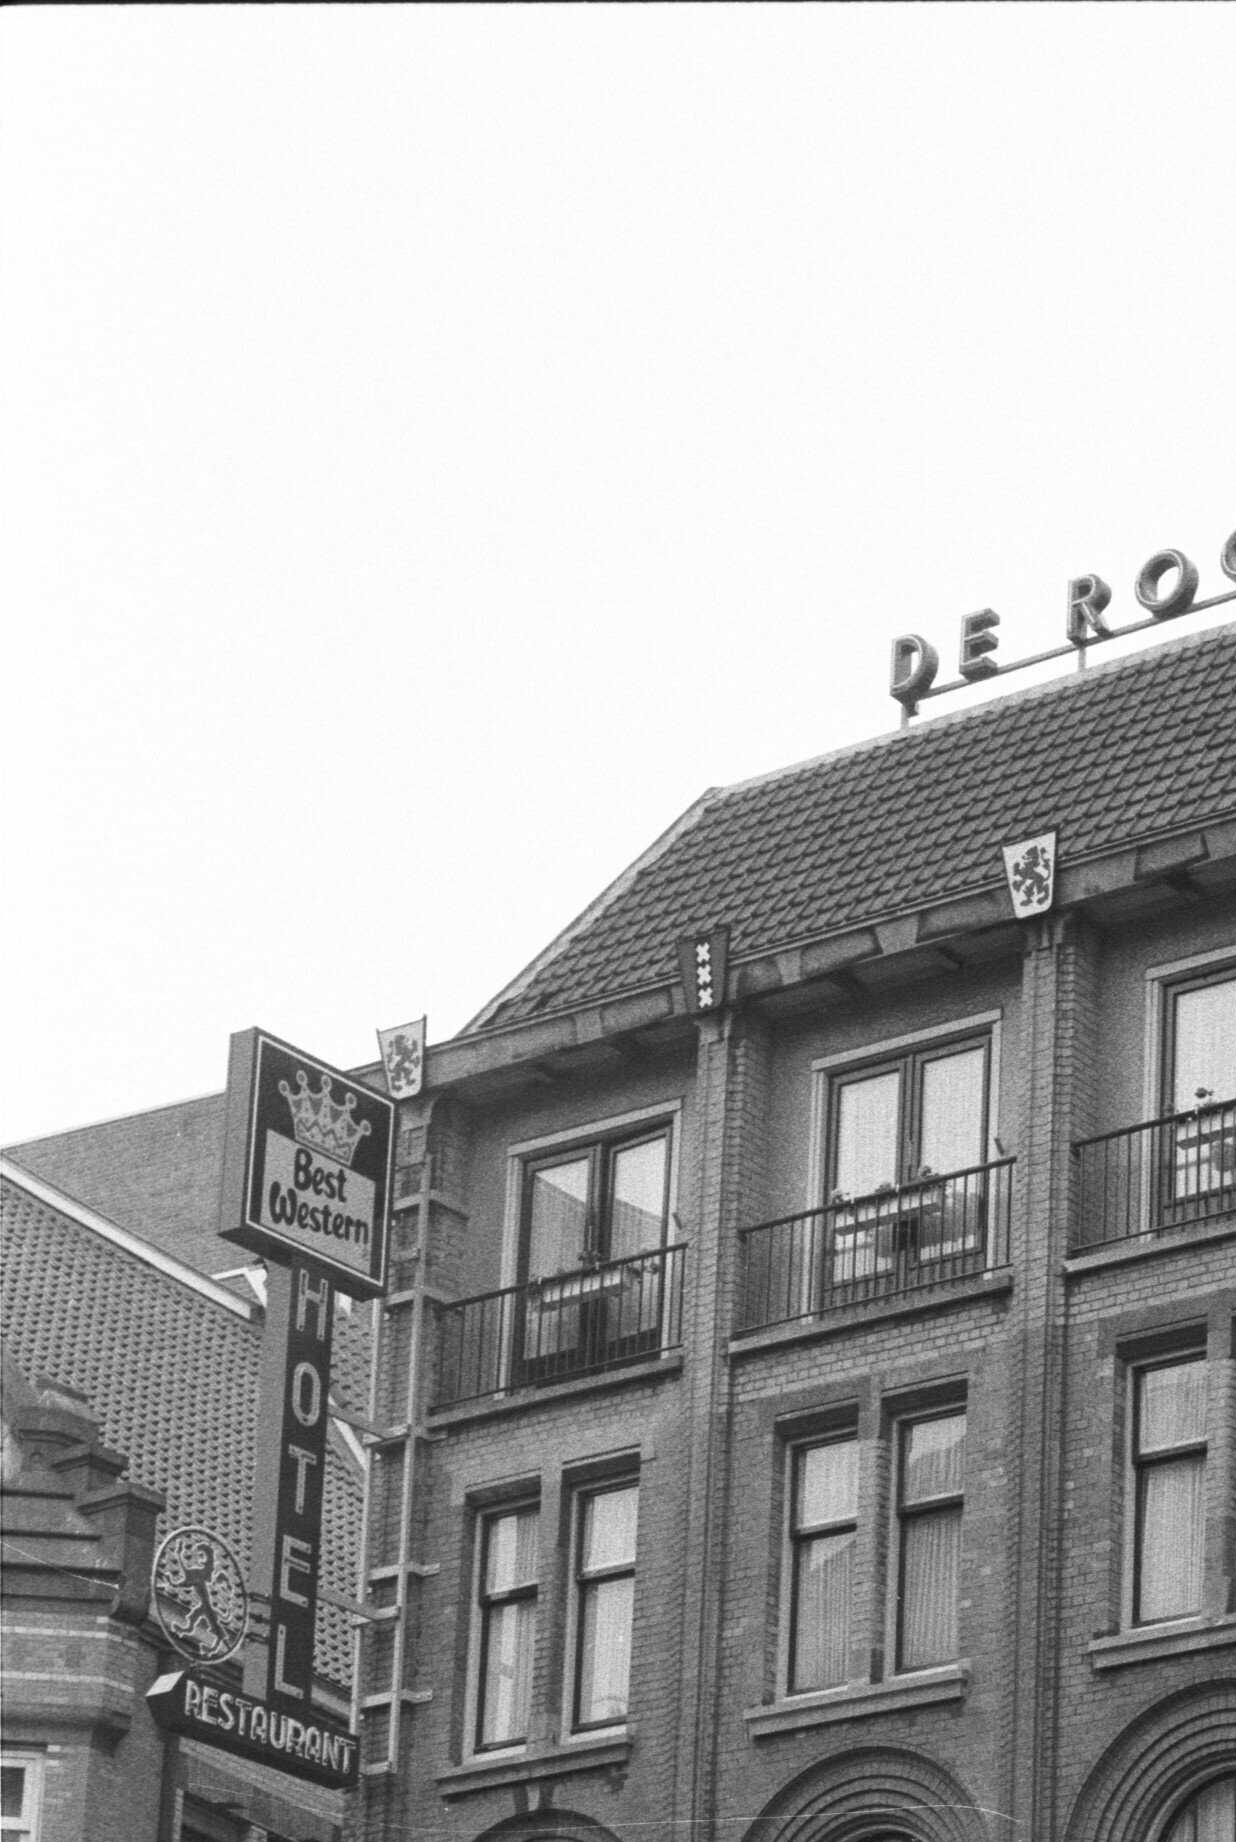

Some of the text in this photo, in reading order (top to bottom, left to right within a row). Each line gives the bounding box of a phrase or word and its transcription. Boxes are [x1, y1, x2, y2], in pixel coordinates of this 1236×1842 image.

[890, 607, 1000, 702] DE
[269, 1181, 369, 1245] Western
[294, 1147, 347, 1202] Best
[274, 1269, 330, 1700] HOTEL
[184, 1679, 357, 1774] RESTAURANT
